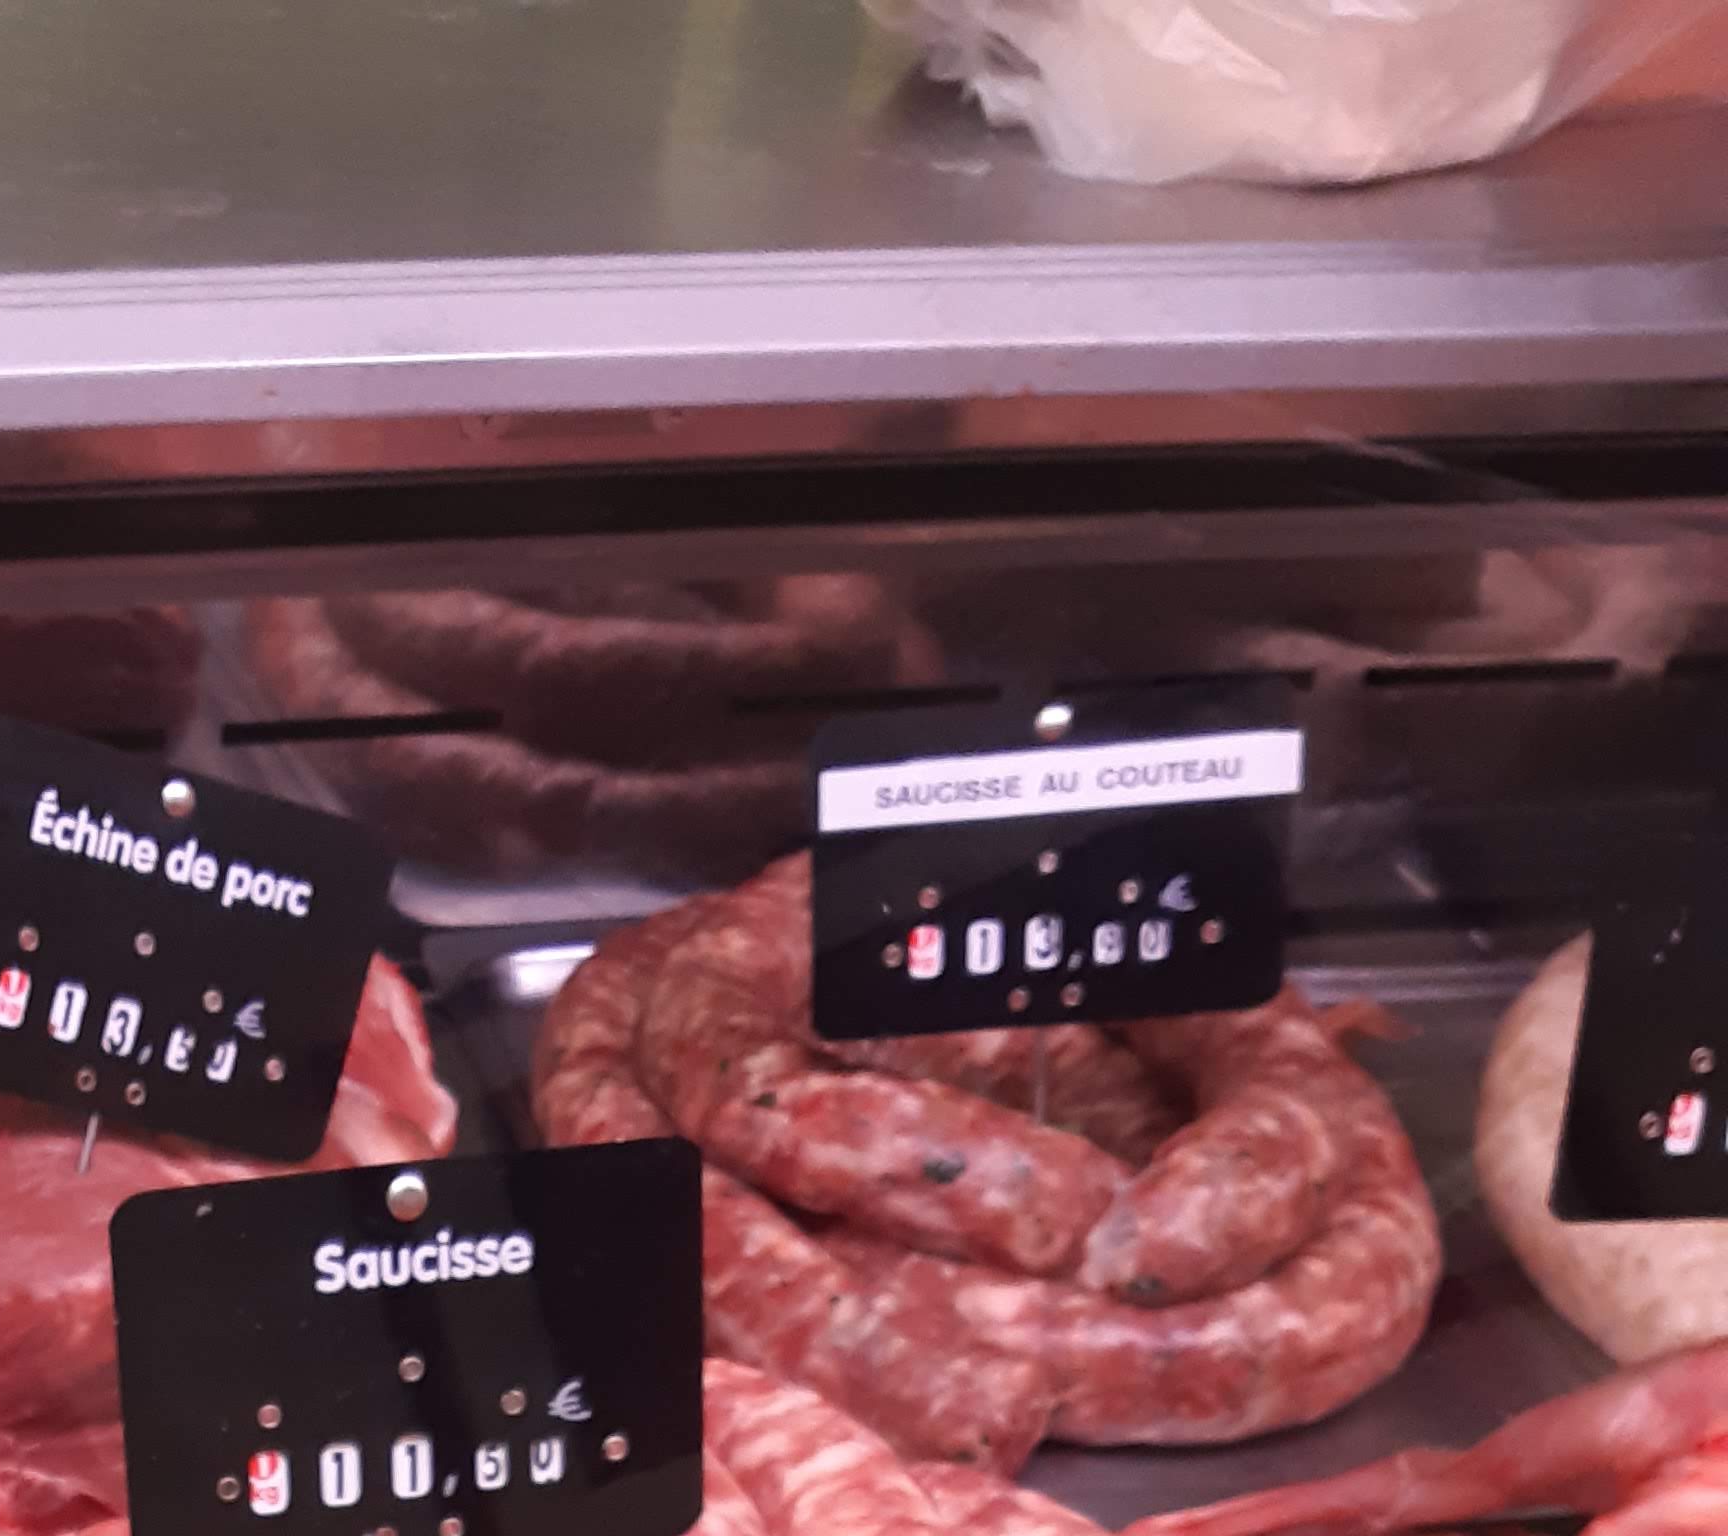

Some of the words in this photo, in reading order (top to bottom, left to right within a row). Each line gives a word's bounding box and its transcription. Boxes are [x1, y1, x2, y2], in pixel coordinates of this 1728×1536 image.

[874, 774, 1023, 810] SAUCISSE
[1039, 768, 1079, 796] AU
[1095, 756, 1245, 791] COUTEAU
[29, 784, 160, 874] Échine
[164, 838, 219, 890] de
[221, 860, 313, 917] porc
[234, 998, 267, 1040] €
[313, 1225, 535, 1294] Saucisse
[548, 1380, 593, 1421] €
